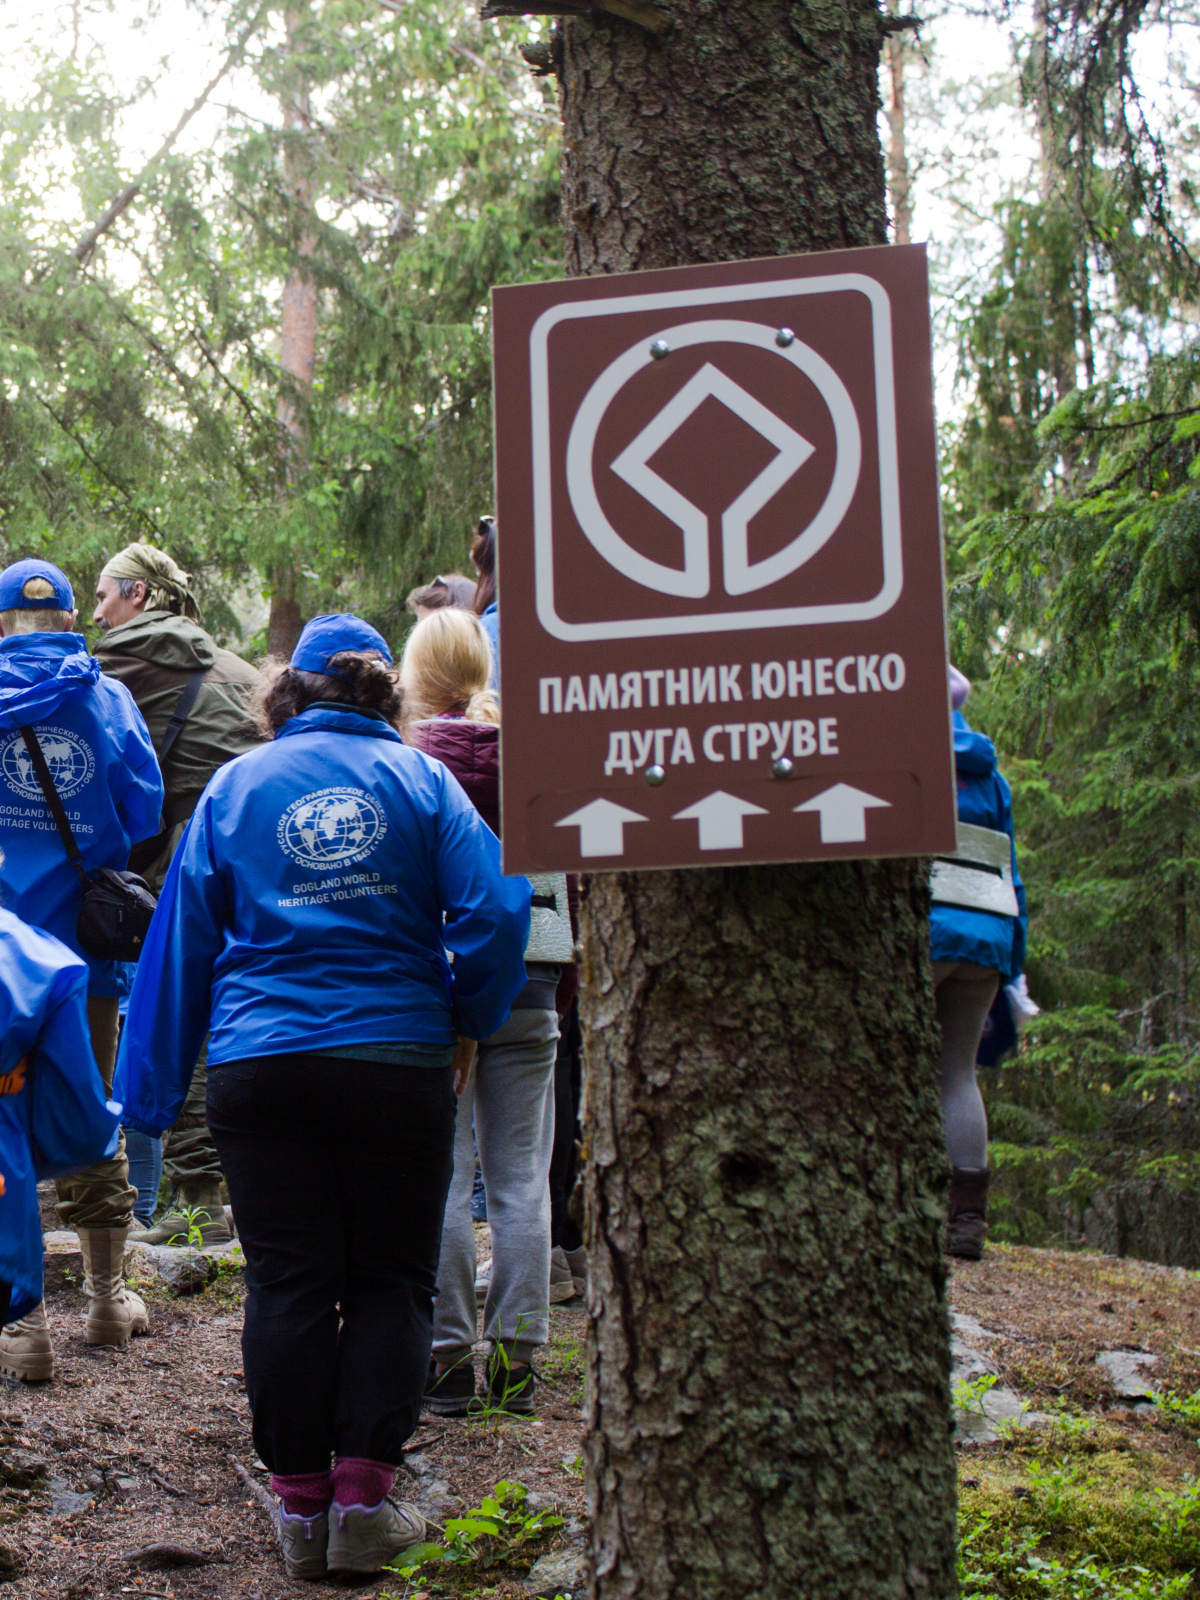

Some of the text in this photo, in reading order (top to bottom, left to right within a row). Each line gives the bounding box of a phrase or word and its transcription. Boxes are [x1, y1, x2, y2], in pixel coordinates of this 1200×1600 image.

[539, 653, 906, 714] ПАМЯТНИК ЮНЕСКО
[6, 725, 79, 742] ГЕОФИЧЕСКОЕ
[78, 739, 95, 784] ОБЩЕСТВО
[604, 717, 839, 775] ДУГА СТРУВЕ
[0, 805, 81, 820] GOGLAND WLD
[276, 787, 388, 855] РУССКОЕ ГЕОГРАФИЧЕСКОЕ ОБЩЕСТВО
[32, 821, 94, 834] VOLUEERS
[294, 855, 343, 871] ОСНОВАНО
[343, 859, 351, 868] В
[351, 848, 372, 863] 1845
[292, 872, 381, 894] GOGLAND WORLD
[277, 884, 399, 907] HERITAGE VOLUNTEERS
